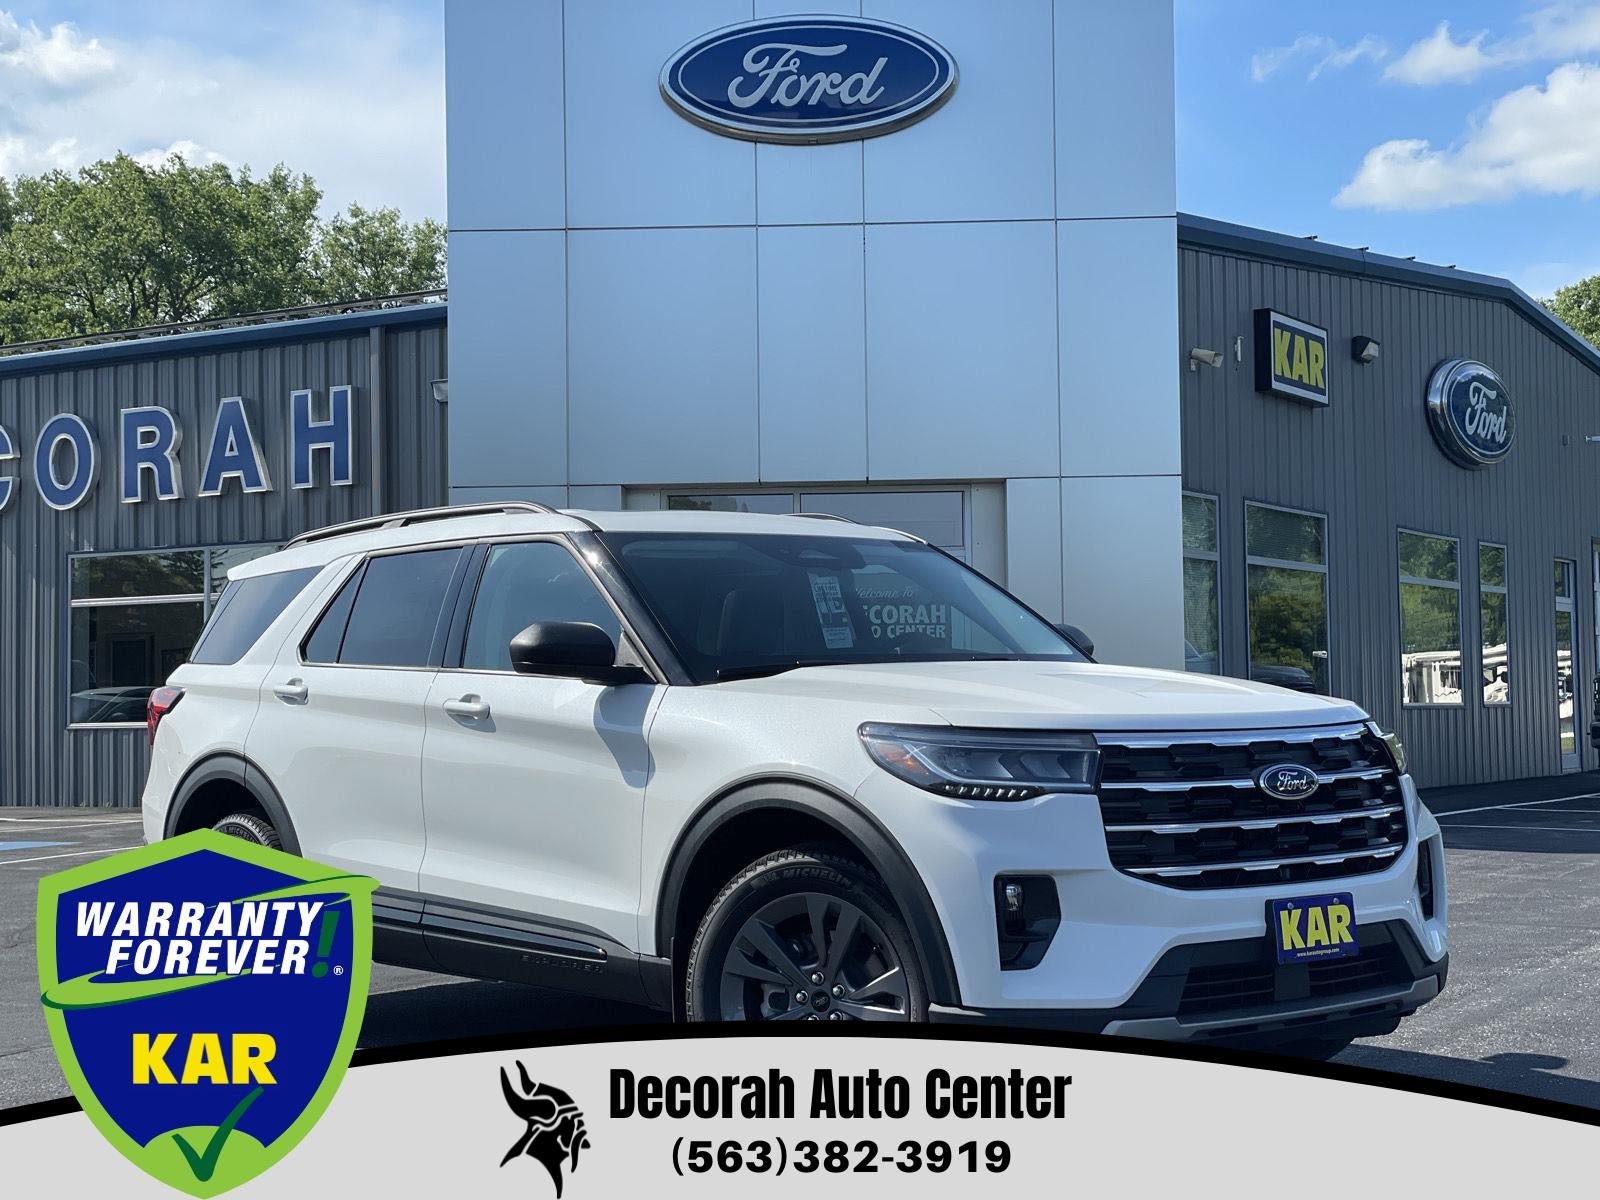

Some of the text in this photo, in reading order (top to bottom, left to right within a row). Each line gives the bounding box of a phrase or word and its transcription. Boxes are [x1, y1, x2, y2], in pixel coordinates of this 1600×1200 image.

[727, 42, 888, 108] Ford
[1273, 327, 1326, 390] KAR
[1465, 381, 1507, 444] Ford
[1277, 771, 1307, 790] Ford
[1279, 903, 1354, 951] KAR
